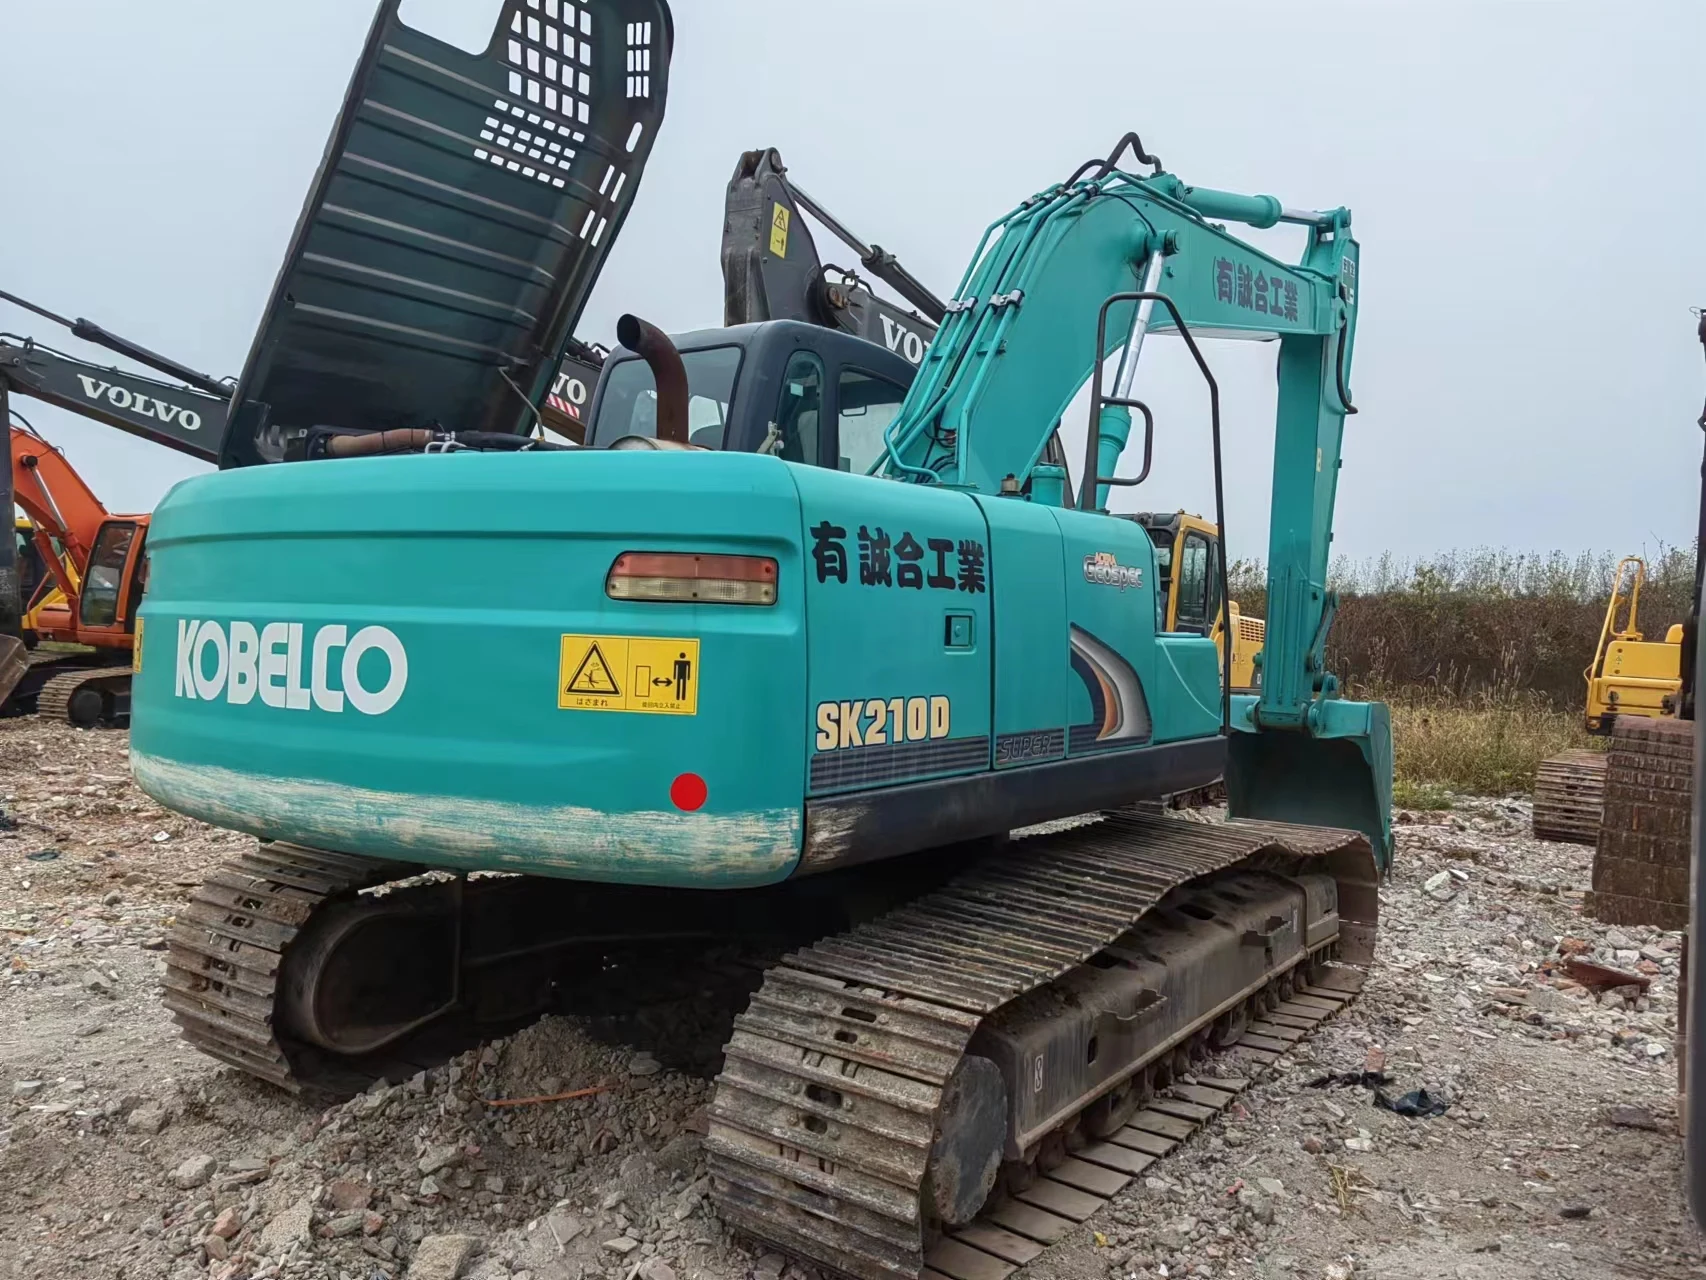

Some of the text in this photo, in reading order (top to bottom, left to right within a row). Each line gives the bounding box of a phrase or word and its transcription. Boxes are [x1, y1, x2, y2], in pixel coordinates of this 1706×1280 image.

[879, 312, 932, 364] VO
[77, 373, 202, 430] VOLVO
[1083, 555, 1143, 593] Geospec
[175, 619, 408, 715] KOBELCO
[576, 698, 608, 707] はさまれ
[816, 695, 950, 752] SK210D
[1000, 735, 1052, 761] SUPER
